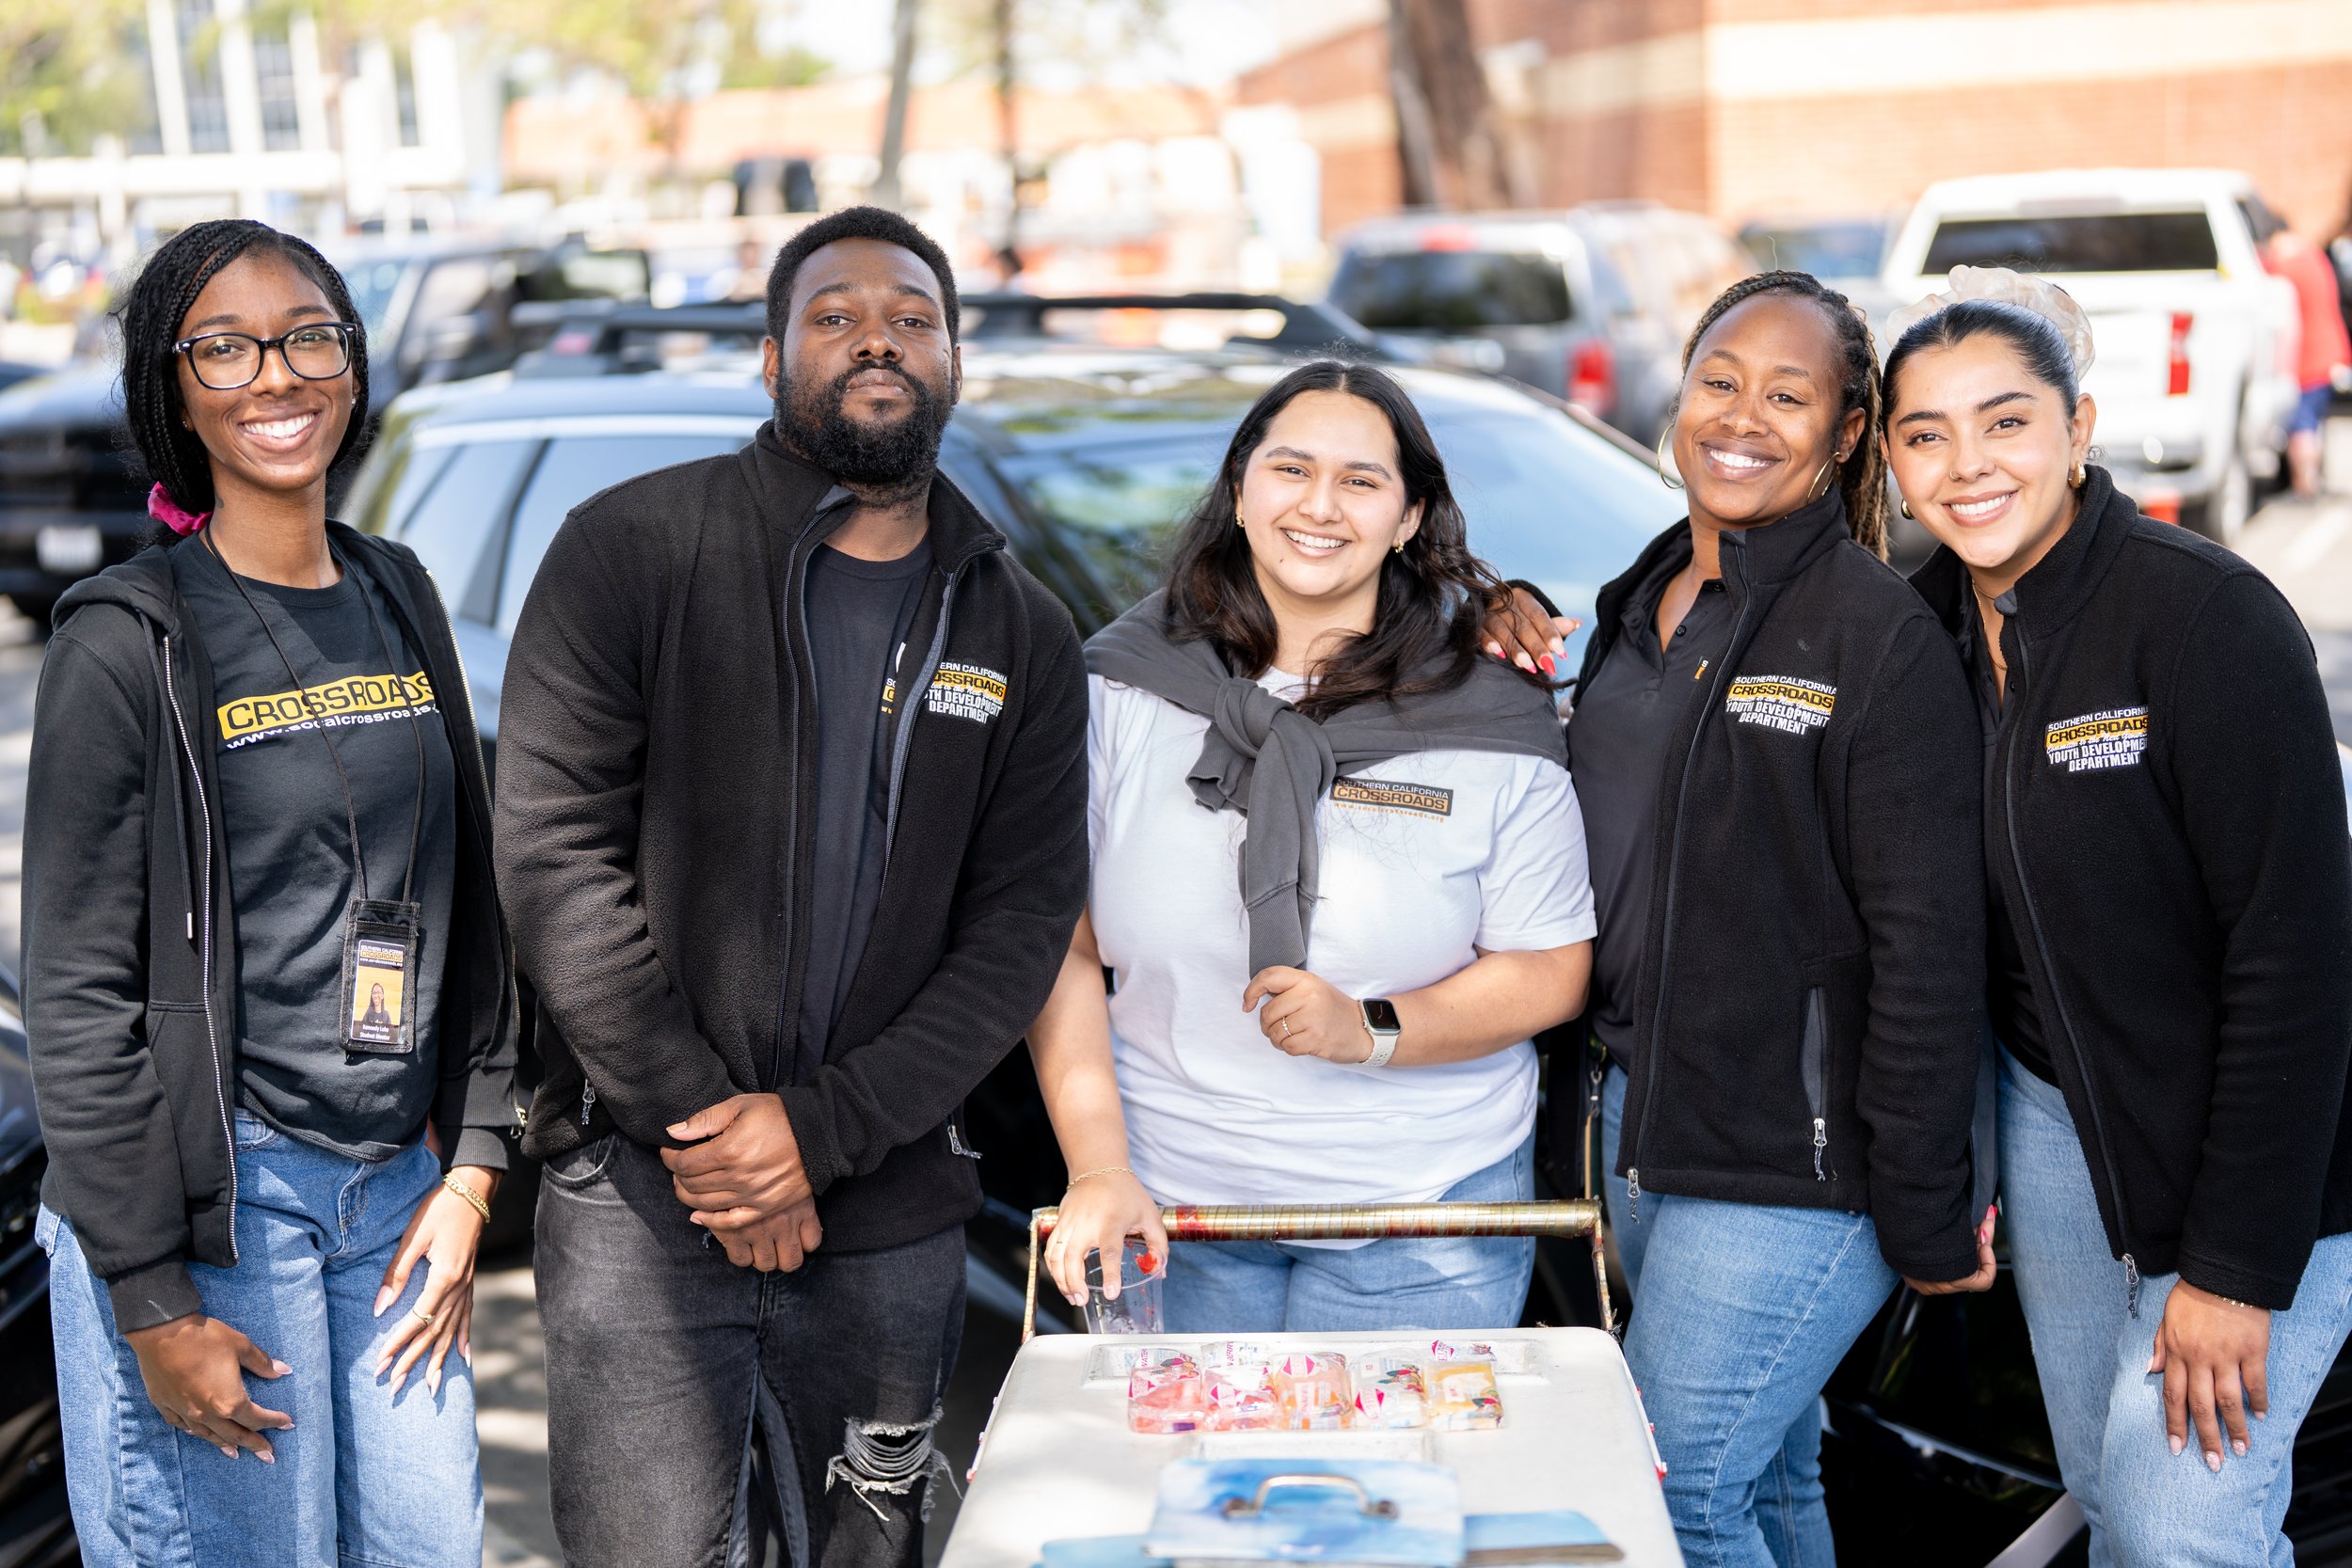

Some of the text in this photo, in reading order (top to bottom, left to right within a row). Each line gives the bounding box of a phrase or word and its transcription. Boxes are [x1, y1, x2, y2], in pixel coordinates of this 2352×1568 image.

[962, 665, 1008, 685] CALIFORNIA
[1735, 675, 1837, 695] SOUTHERN CALIFORNIA
[945, 690, 1003, 717] DEVELOPMENT
[1732, 685, 1834, 709] CROSSROADS
[929, 700, 990, 724] DEPARTMENT
[1726, 701, 1830, 728] YOUTH DEVELOPMENT
[1739, 711, 1809, 736] DEPARTMENT
[2048, 713, 2093, 732] SOUTHERN
[2048, 747, 2079, 765] YOUTH
[2081, 737, 2148, 758] DEVELOPME
[2069, 752, 2141, 772] DEPARTMENT
[1337, 780, 1449, 799] SOUTHERN CALIFORNIA
[1338, 787, 1445, 810] CROSSROADS
[361, 950, 403, 961] CROSSROADS
